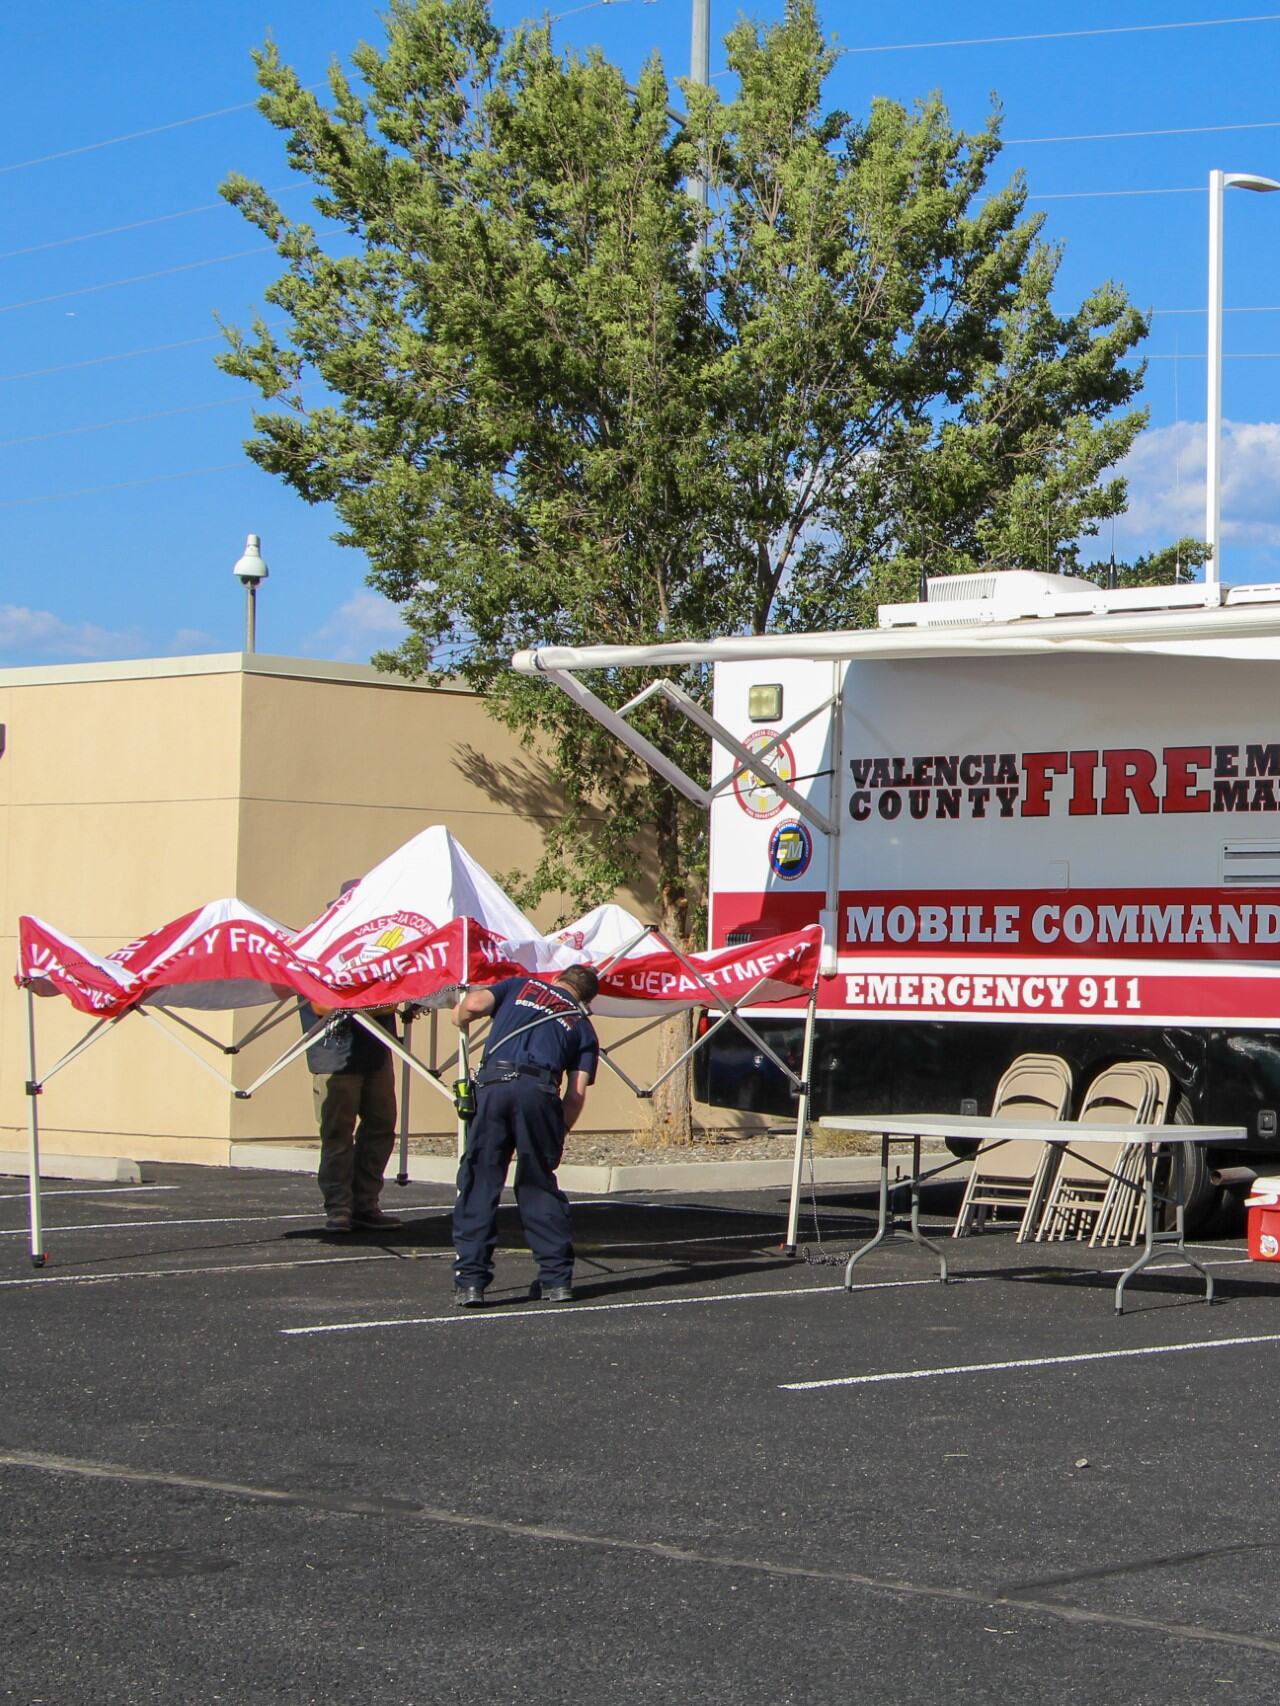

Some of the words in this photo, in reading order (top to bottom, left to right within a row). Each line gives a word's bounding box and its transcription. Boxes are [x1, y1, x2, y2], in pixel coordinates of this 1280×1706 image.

[850, 753, 1020, 789] VALENCIA
[1021, 746, 1212, 817] FIRE
[849, 787, 1019, 821] COUNTY
[846, 905, 1020, 943] MOBILE
[845, 975, 1069, 1008] EMERGENCY
[1078, 976, 1142, 1009] 911
